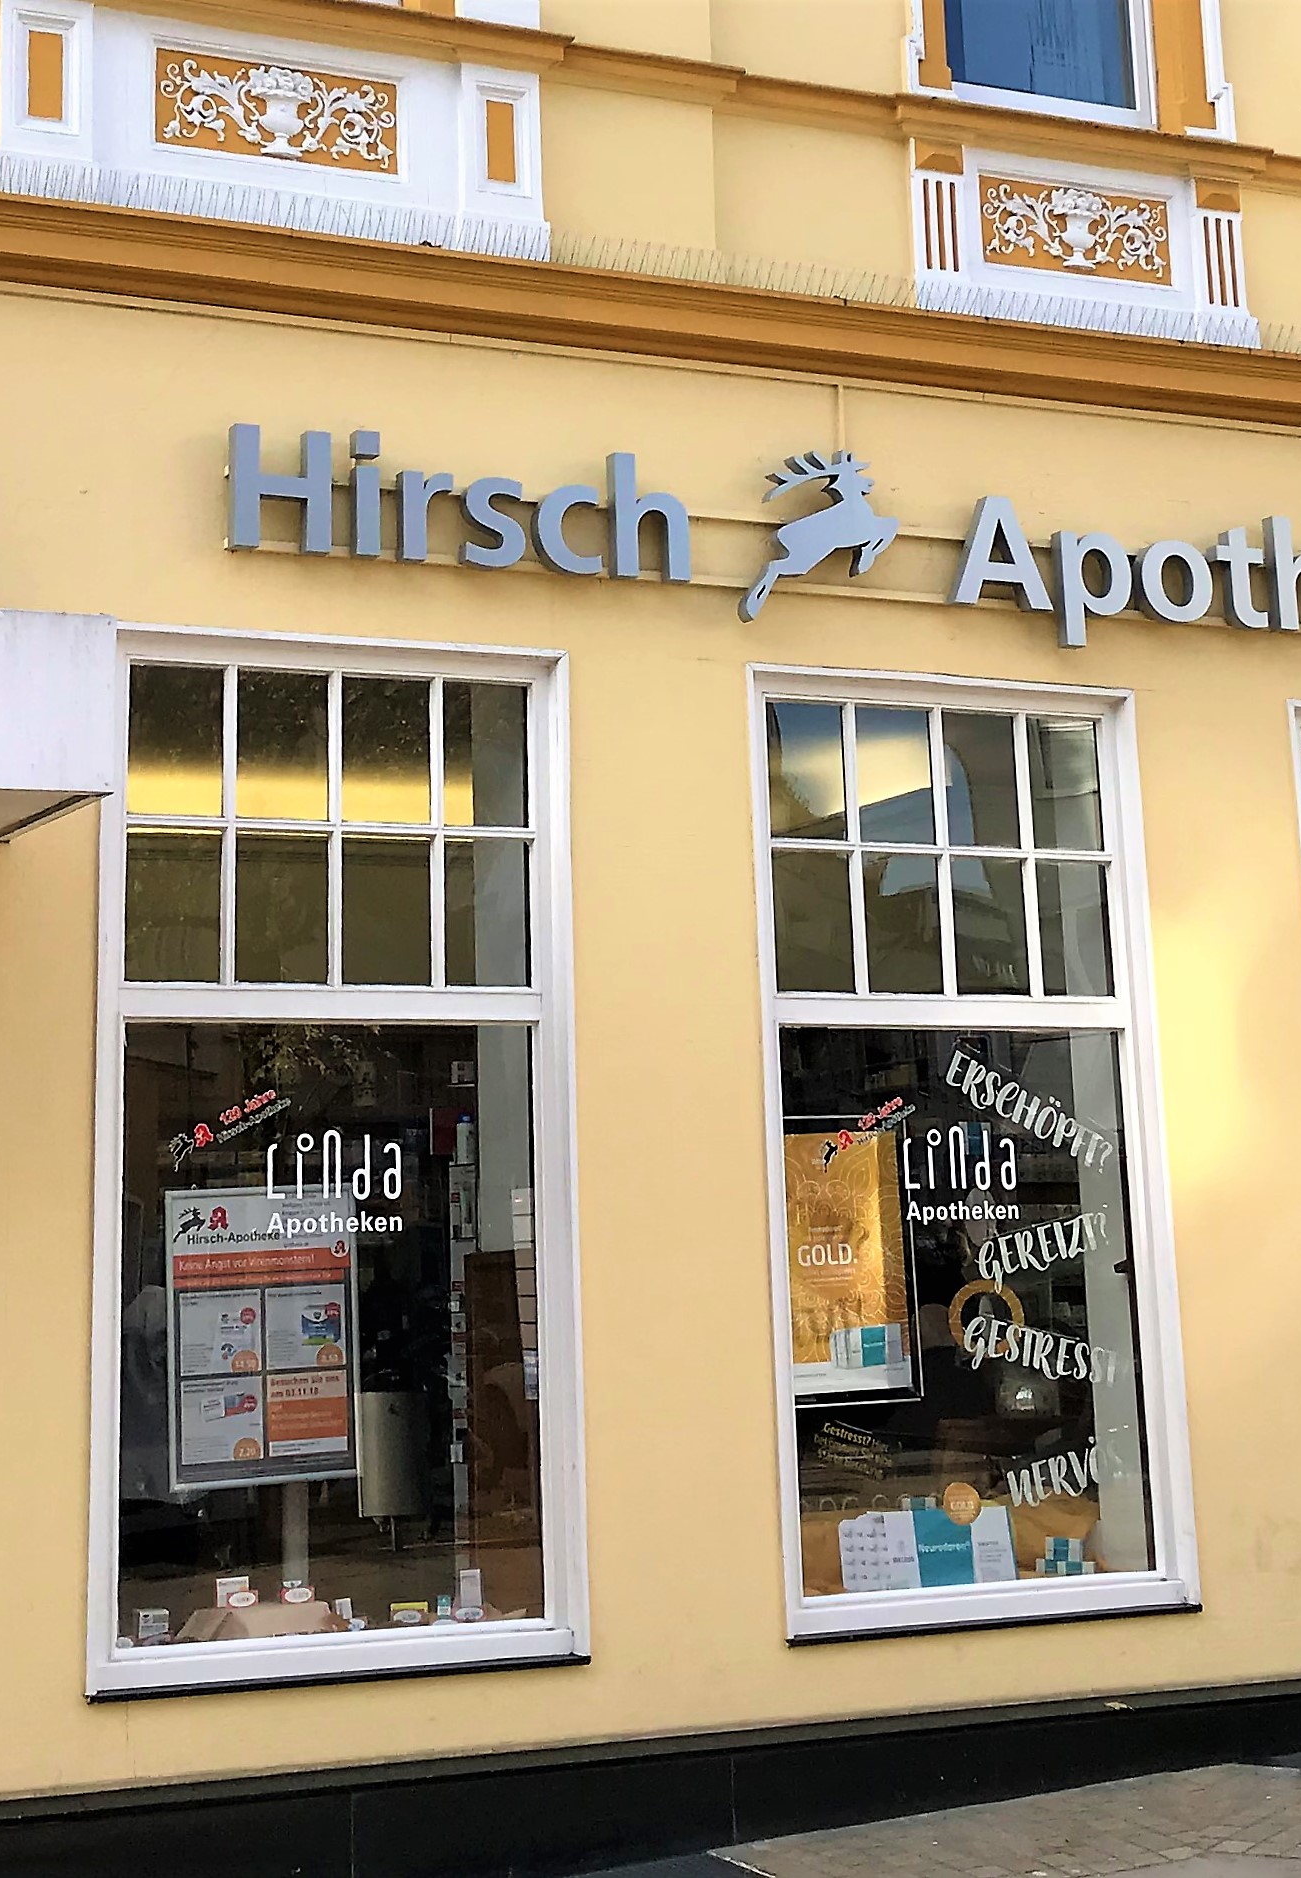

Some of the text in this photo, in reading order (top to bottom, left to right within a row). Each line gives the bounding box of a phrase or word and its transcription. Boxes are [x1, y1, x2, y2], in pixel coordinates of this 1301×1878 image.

[228, 423, 690, 583] Hirsch
[266, 1210, 403, 1239] Apotheken
[906, 1200, 1020, 1226] Apotheken
[798, 1244, 858, 1267] GOLD.
